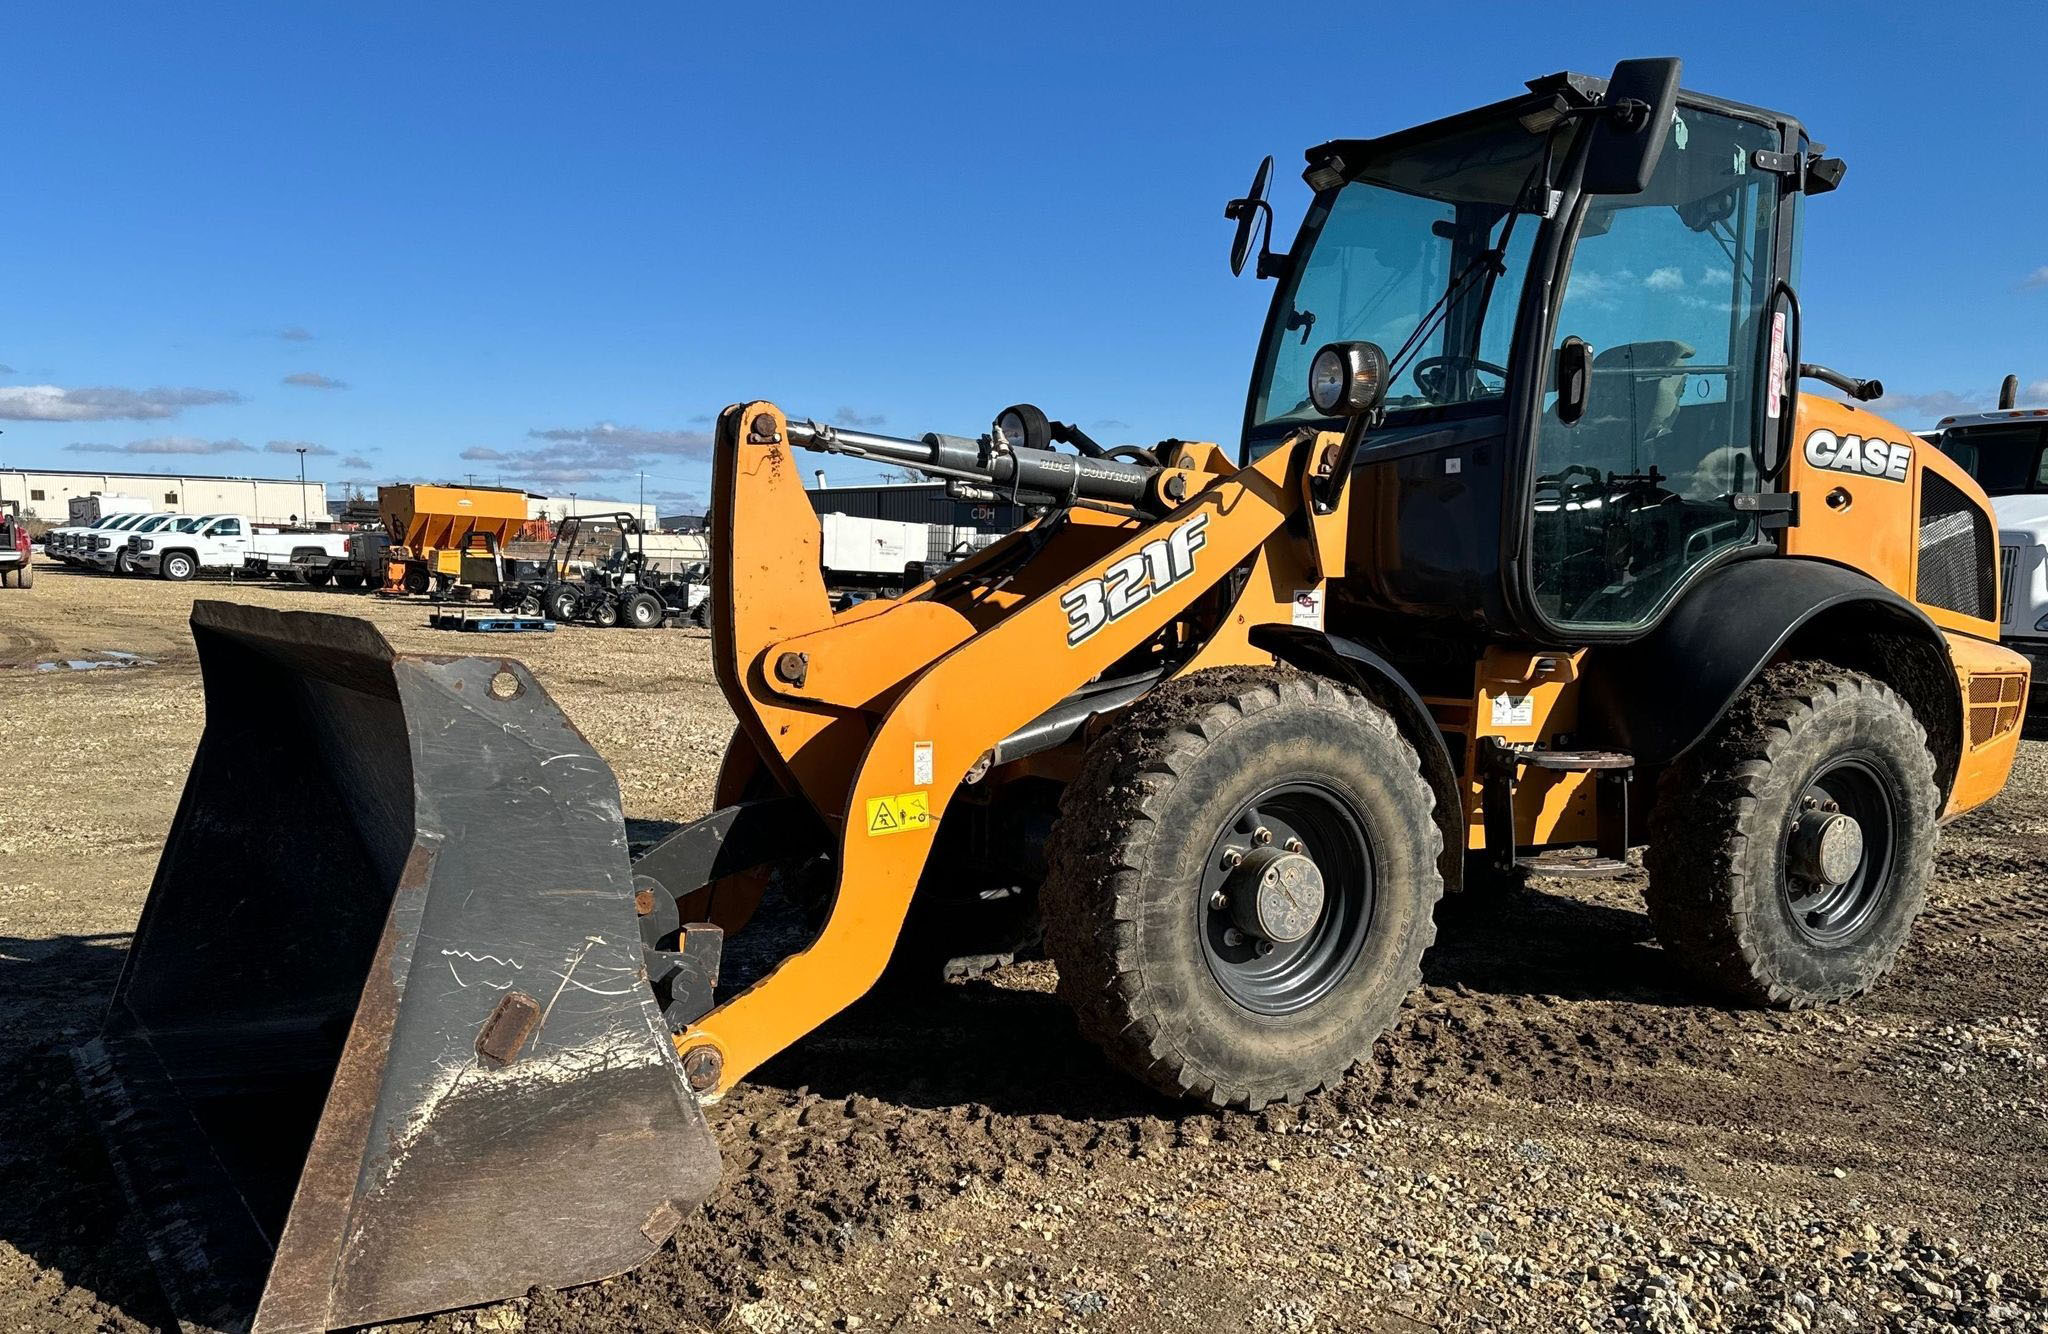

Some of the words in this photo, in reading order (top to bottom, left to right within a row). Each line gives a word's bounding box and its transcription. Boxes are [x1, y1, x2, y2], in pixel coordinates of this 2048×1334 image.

[1039, 460, 1071, 473] RIDE
[1080, 467, 1139, 484] CONTROL
[1803, 428, 1912, 483] CASE
[970, 507, 995, 520] CDH
[1060, 512, 1209, 648] 321F
